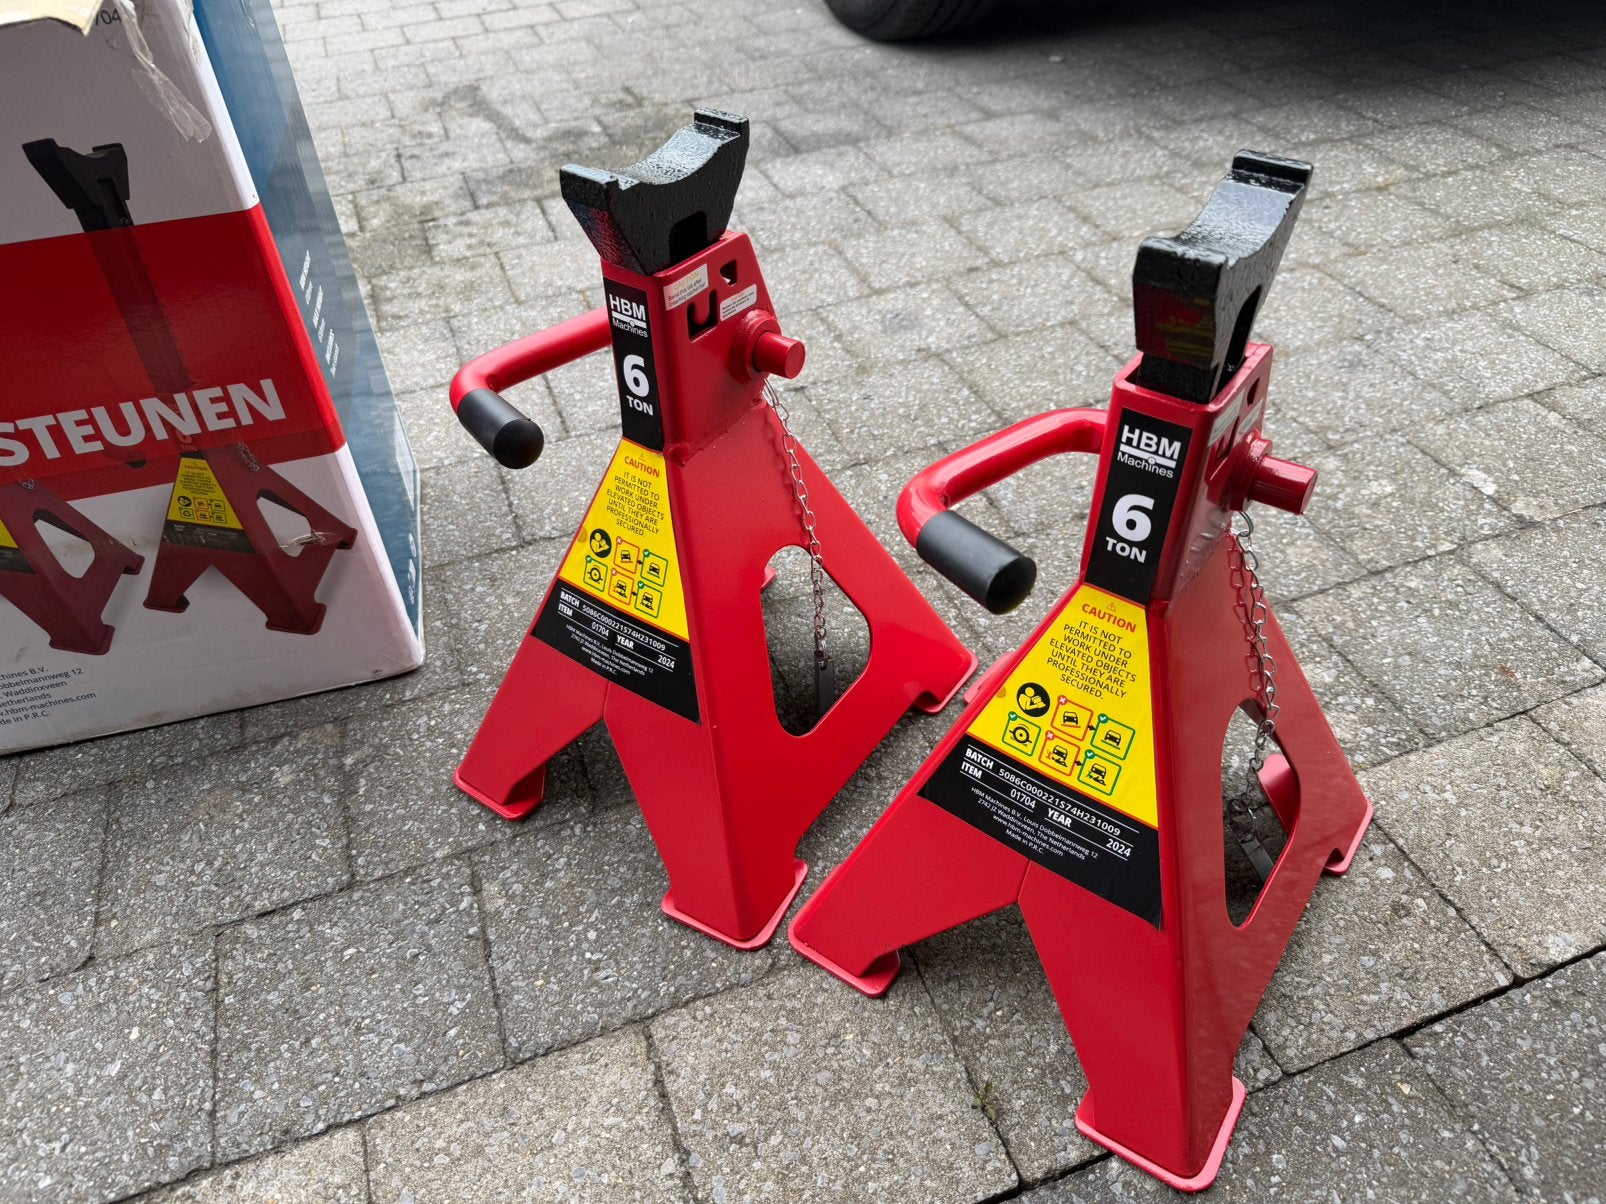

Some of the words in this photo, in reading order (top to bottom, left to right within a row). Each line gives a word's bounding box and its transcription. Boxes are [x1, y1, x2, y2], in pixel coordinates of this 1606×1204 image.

[609, 293, 646, 321] HBM
[612, 317, 648, 338] Machines
[623, 354, 650, 398] 6
[626, 395, 654, 416] TON
[0, 378, 286, 467] STEUNEN
[1121, 424, 1182, 460] HBM
[624, 456, 660, 478] CAUTION
[1117, 451, 1174, 478] Machines
[615, 476, 649, 496] PERMITTED
[650, 492, 660, 501] TO
[624, 471, 630, 479] IT
[638, 478, 652, 489] NOT
[607, 489, 635, 507] ELEVATED
[637, 504, 665, 520] OBJECTS
[616, 485, 633, 498] WORK
[635, 494, 658, 509] UNDER
[607, 506, 660, 535] PROFESSIONALLY
[609, 498, 626, 511] UNTIL
[628, 507, 644, 519] THEY
[645, 515, 658, 526] ARE
[1112, 493, 1155, 542] 6
[1105, 536, 1147, 563] TON
[560, 591, 580, 607] BATCH
[1082, 604, 1137, 633] CAUTION
[558, 603, 573, 617] ITEM
[591, 621, 609, 637] 01704
[617, 634, 634, 650] YEAR
[658, 654, 675, 669] 2024
[1064, 624, 1116, 652] PERMITTED
[1119, 647, 1132, 659] TO
[1079, 621, 1088, 630] IT
[1090, 625, 1099, 635] IS
[1101, 630, 1123, 645] NOT
[1050, 638, 1094, 663] ELEVATED
[1096, 660, 1137, 682] OBJECTS
[1064, 634, 1092, 653] WORK
[1094, 648, 1128, 669] UNDER
[29, 666, 48, 676] B.V.
[71, 668, 83, 676] 12
[1047, 657, 1127, 698] PROFESSIONALLY
[1052, 649, 1077, 668] UNTIL
[1081, 662, 1105, 678] THEY
[1106, 675, 1126, 688] ARE
[3, 680, 67, 698] Waddinxveen
[1060, 674, 1104, 700] SECURED.
[24, 710, 51, 720] P.R.C.
[965, 748, 994, 770] BATCH
[961, 761, 982, 779] ITEM
[1010, 789, 1036, 809] 01704
[1047, 808, 1072, 828] YEAR
[1106, 838, 1132, 857] 2024
[971, 787, 985, 798] HBM
[985, 795, 1011, 812] Machines
[1023, 816, 1039, 829] Louis
[1039, 824, 1090, 856] Dobbelmannweg
[1091, 851, 1099, 859] 12
[978, 798, 991, 809] 2742
[1037, 830, 1048, 841] The
[1048, 837, 1085, 860] Netherlands
[993, 815, 1064, 857] www.hbm-machines.com
[1006, 829, 1022, 842] Made
[1029, 842, 1044, 855] P.R.C.
